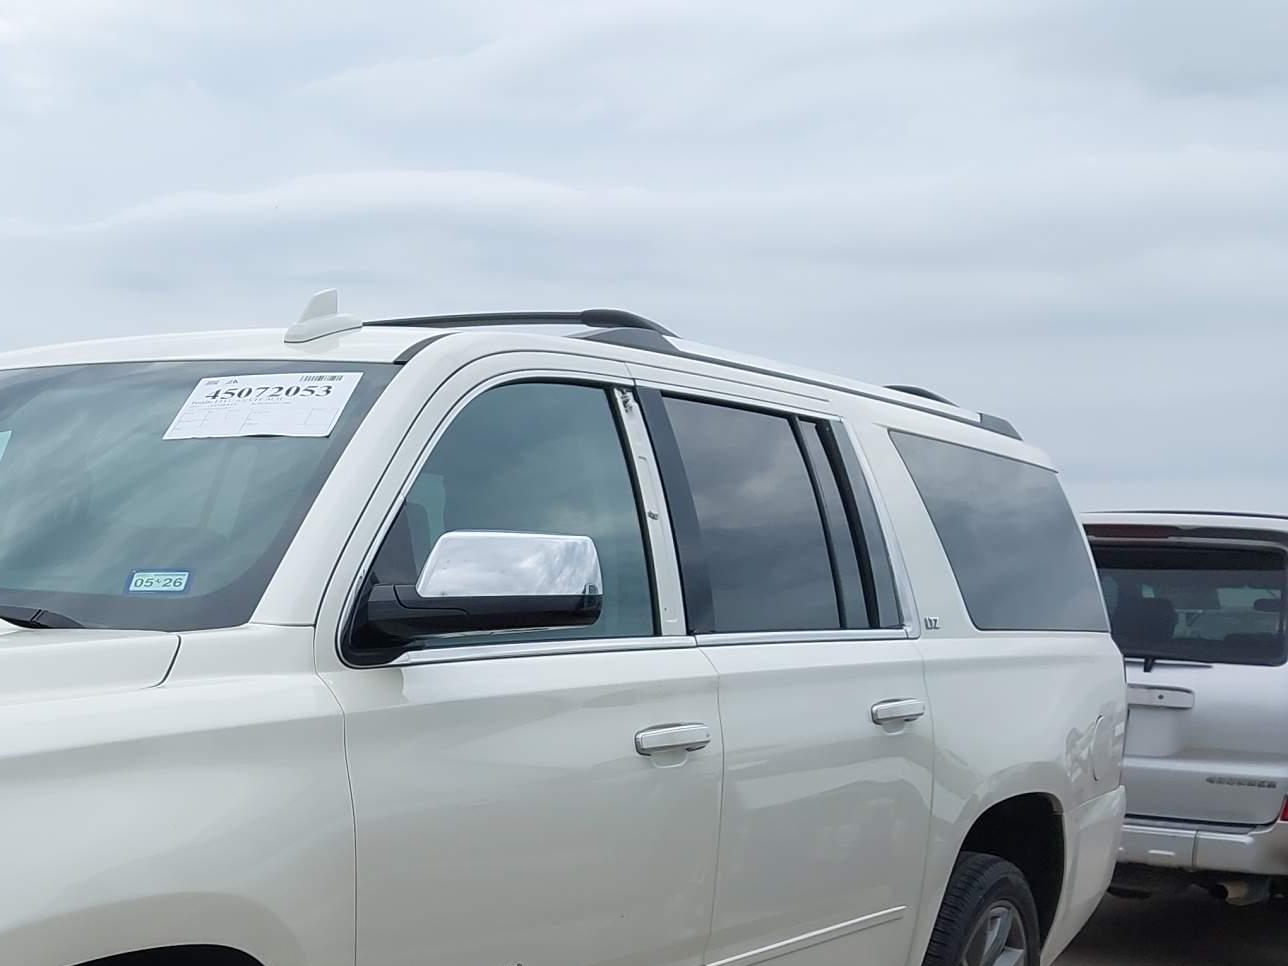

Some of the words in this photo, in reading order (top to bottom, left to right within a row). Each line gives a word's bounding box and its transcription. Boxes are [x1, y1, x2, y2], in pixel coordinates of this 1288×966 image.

[205, 385, 333, 400] 45072053
[134, 578, 154, 588] 05
[162, 577, 184, 588] 26
